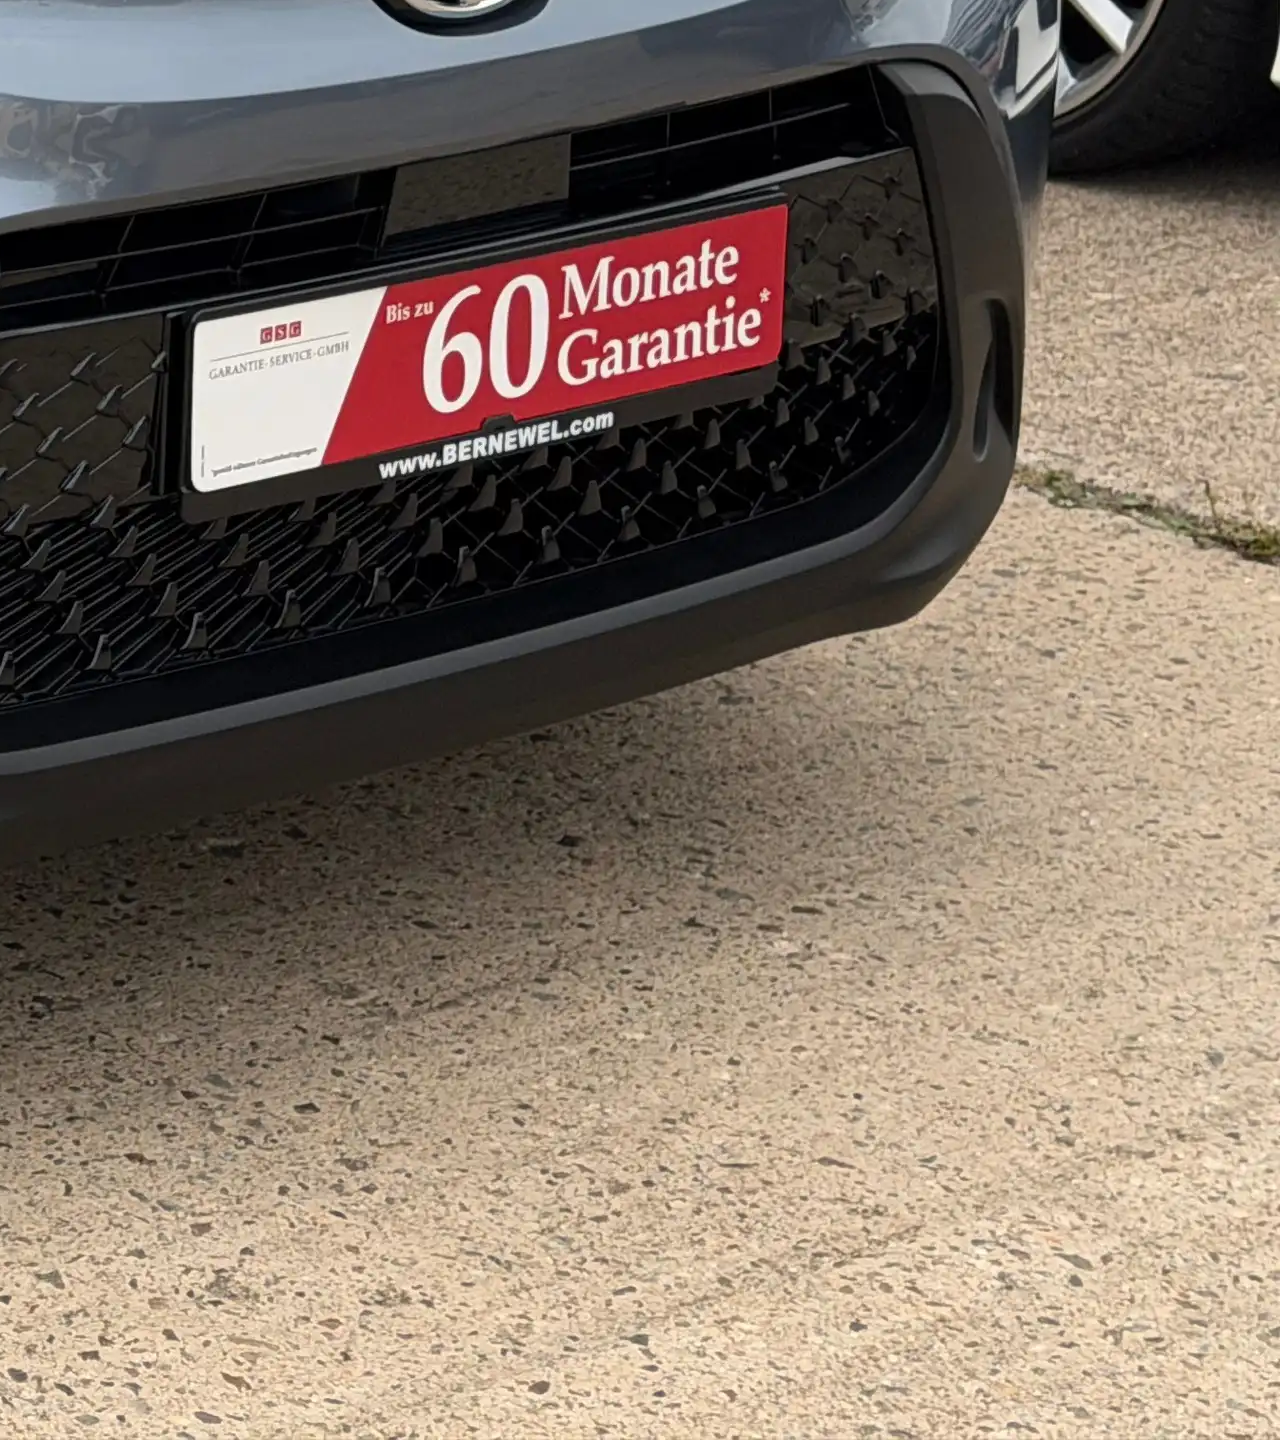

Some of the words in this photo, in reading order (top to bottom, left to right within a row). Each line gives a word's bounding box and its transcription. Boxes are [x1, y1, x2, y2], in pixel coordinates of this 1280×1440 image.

[558, 238, 740, 320] Monate
[260, 320, 302, 345] GSG
[385, 302, 410, 325] Bis
[412, 300, 434, 319] zu
[422, 273, 550, 414] 60
[378, 410, 615, 480] www.BERNEWEL.com
